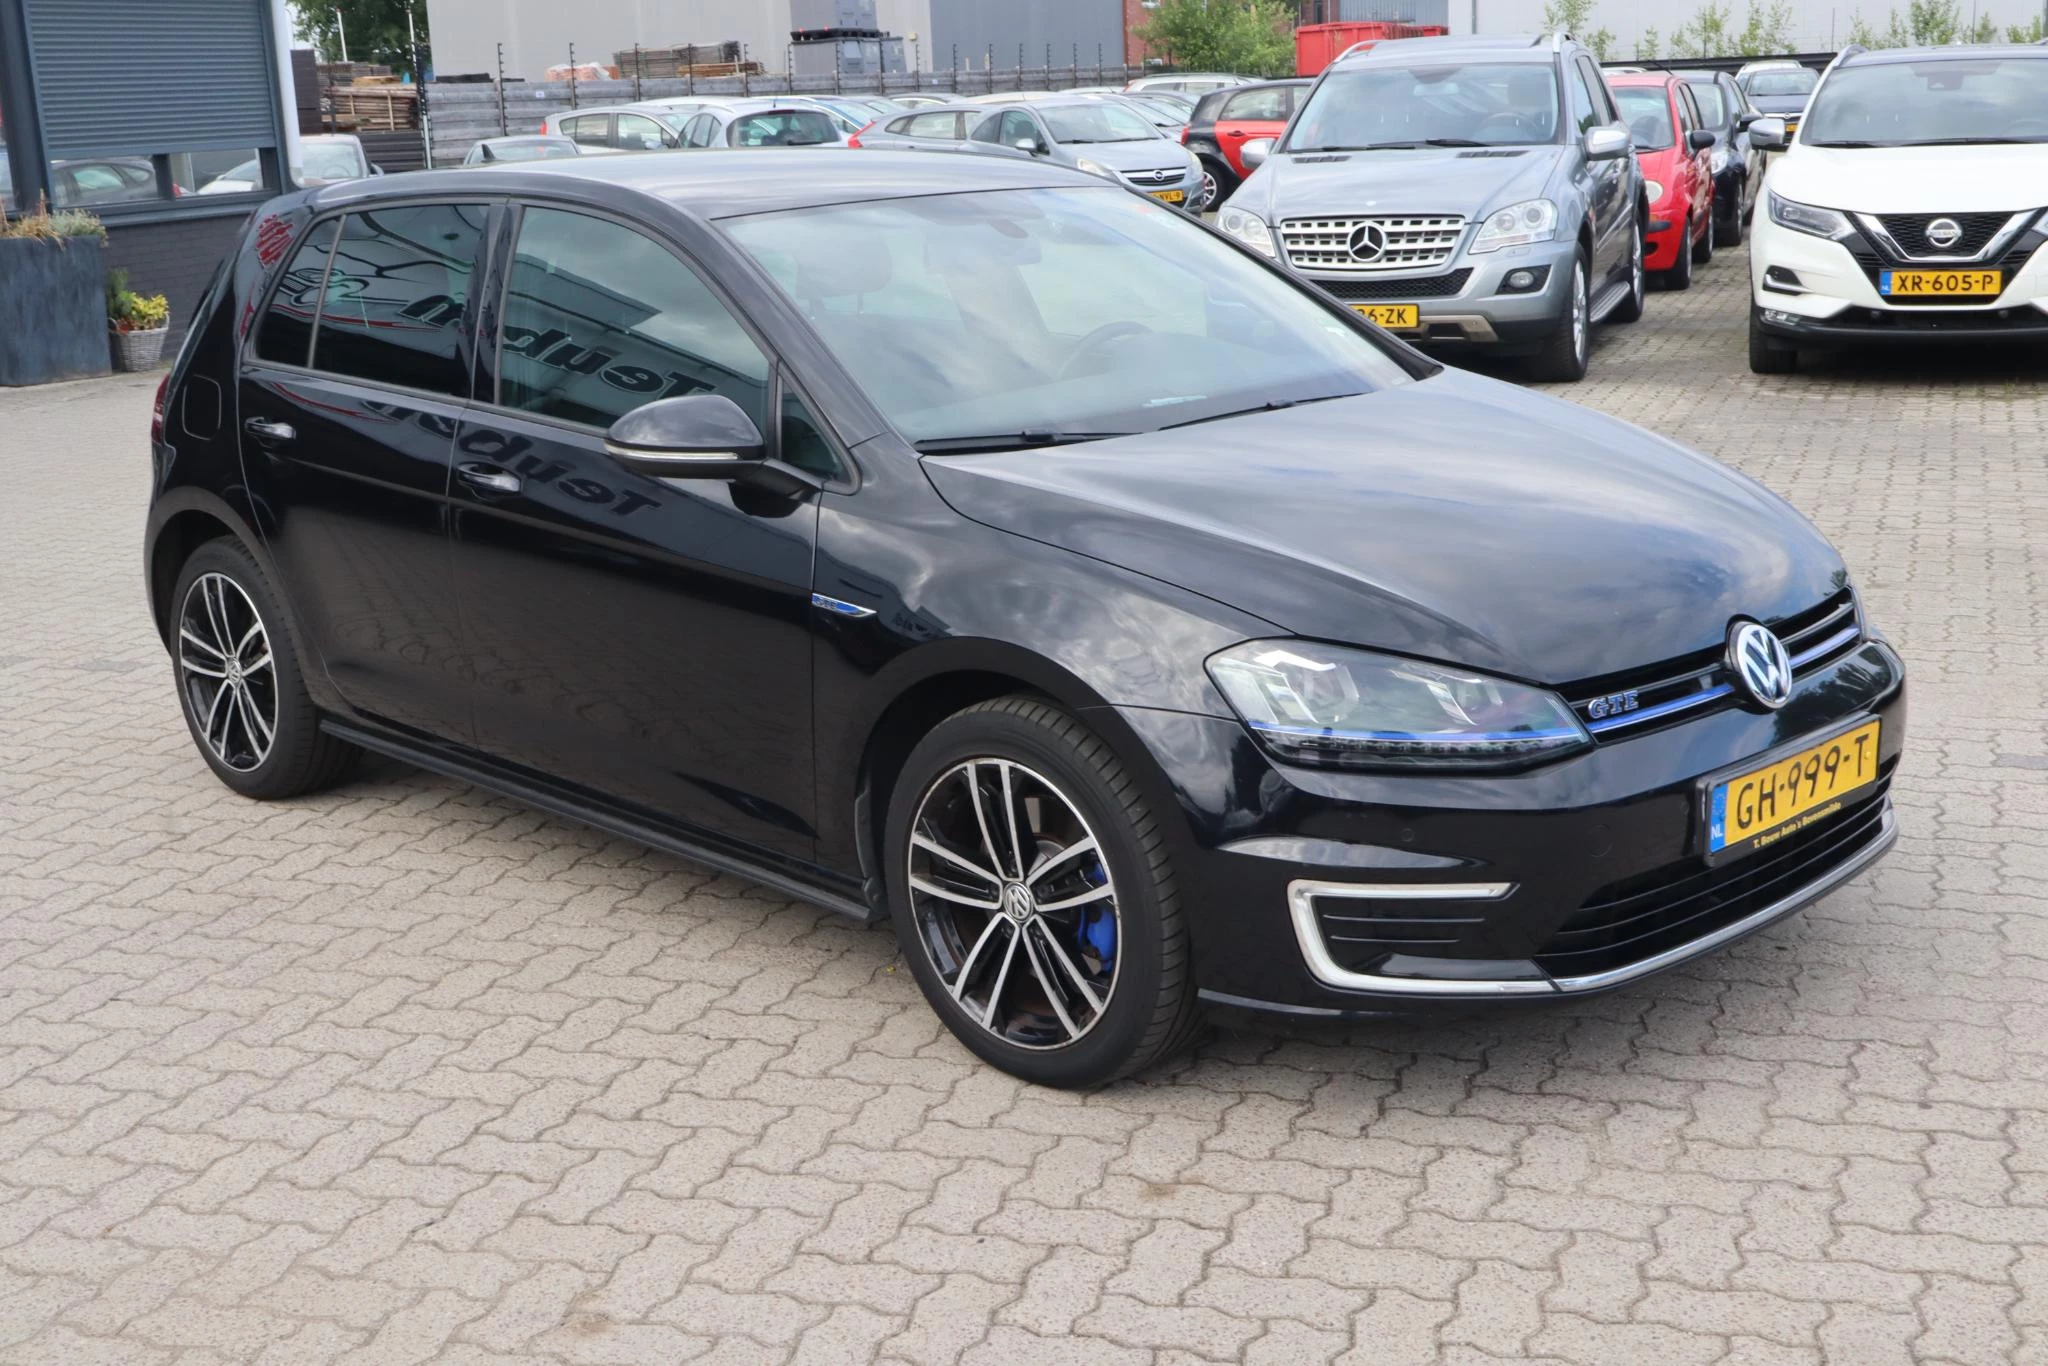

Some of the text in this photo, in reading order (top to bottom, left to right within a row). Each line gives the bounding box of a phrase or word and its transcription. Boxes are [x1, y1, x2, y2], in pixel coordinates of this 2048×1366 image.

[1898, 274, 1994, 291] XR-605-P
[1588, 690, 1639, 718] GTE
[1737, 733, 1870, 829] GH-999-T
[1711, 824, 1724, 840] NL
